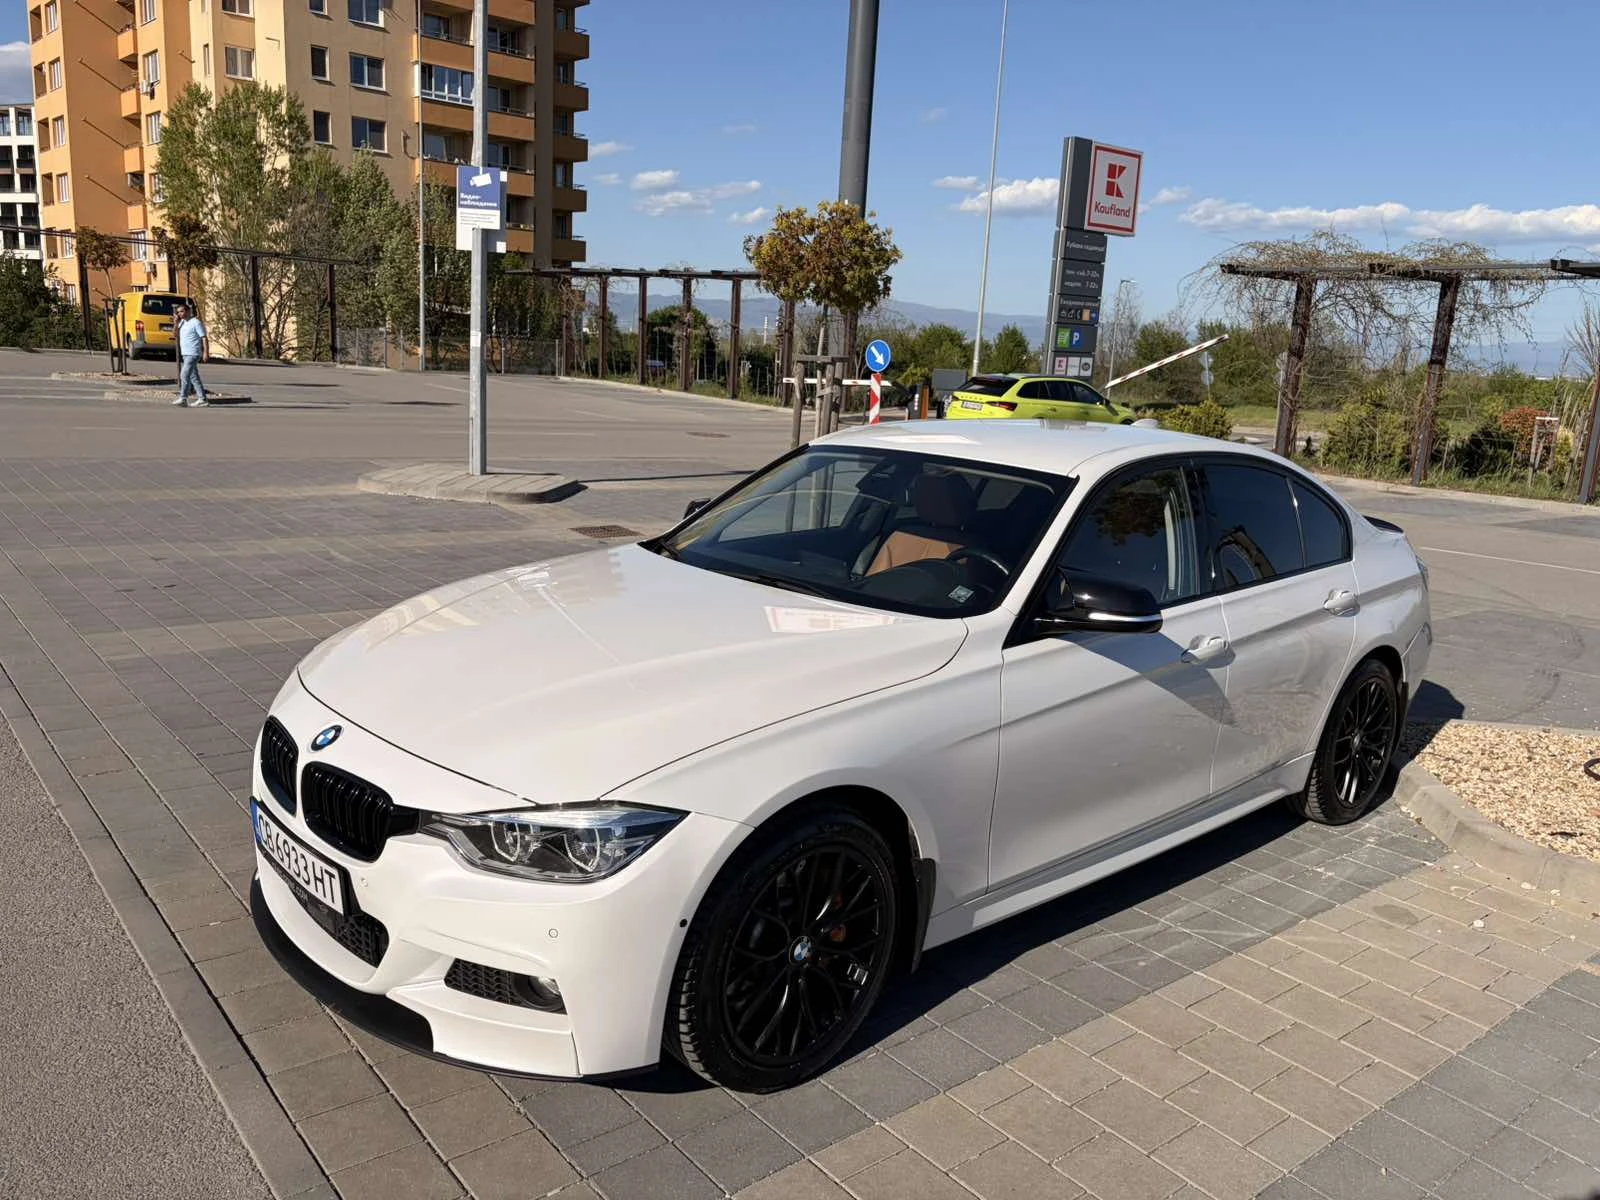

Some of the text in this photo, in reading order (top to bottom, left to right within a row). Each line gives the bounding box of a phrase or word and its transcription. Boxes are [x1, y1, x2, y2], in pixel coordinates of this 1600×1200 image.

[1105, 163, 1127, 198] K
[1094, 201, 1131, 217] Kaufland
[1072, 332, 1080, 345] P
[276, 832, 310, 886] 6933
[312, 861, 336, 904] HT
